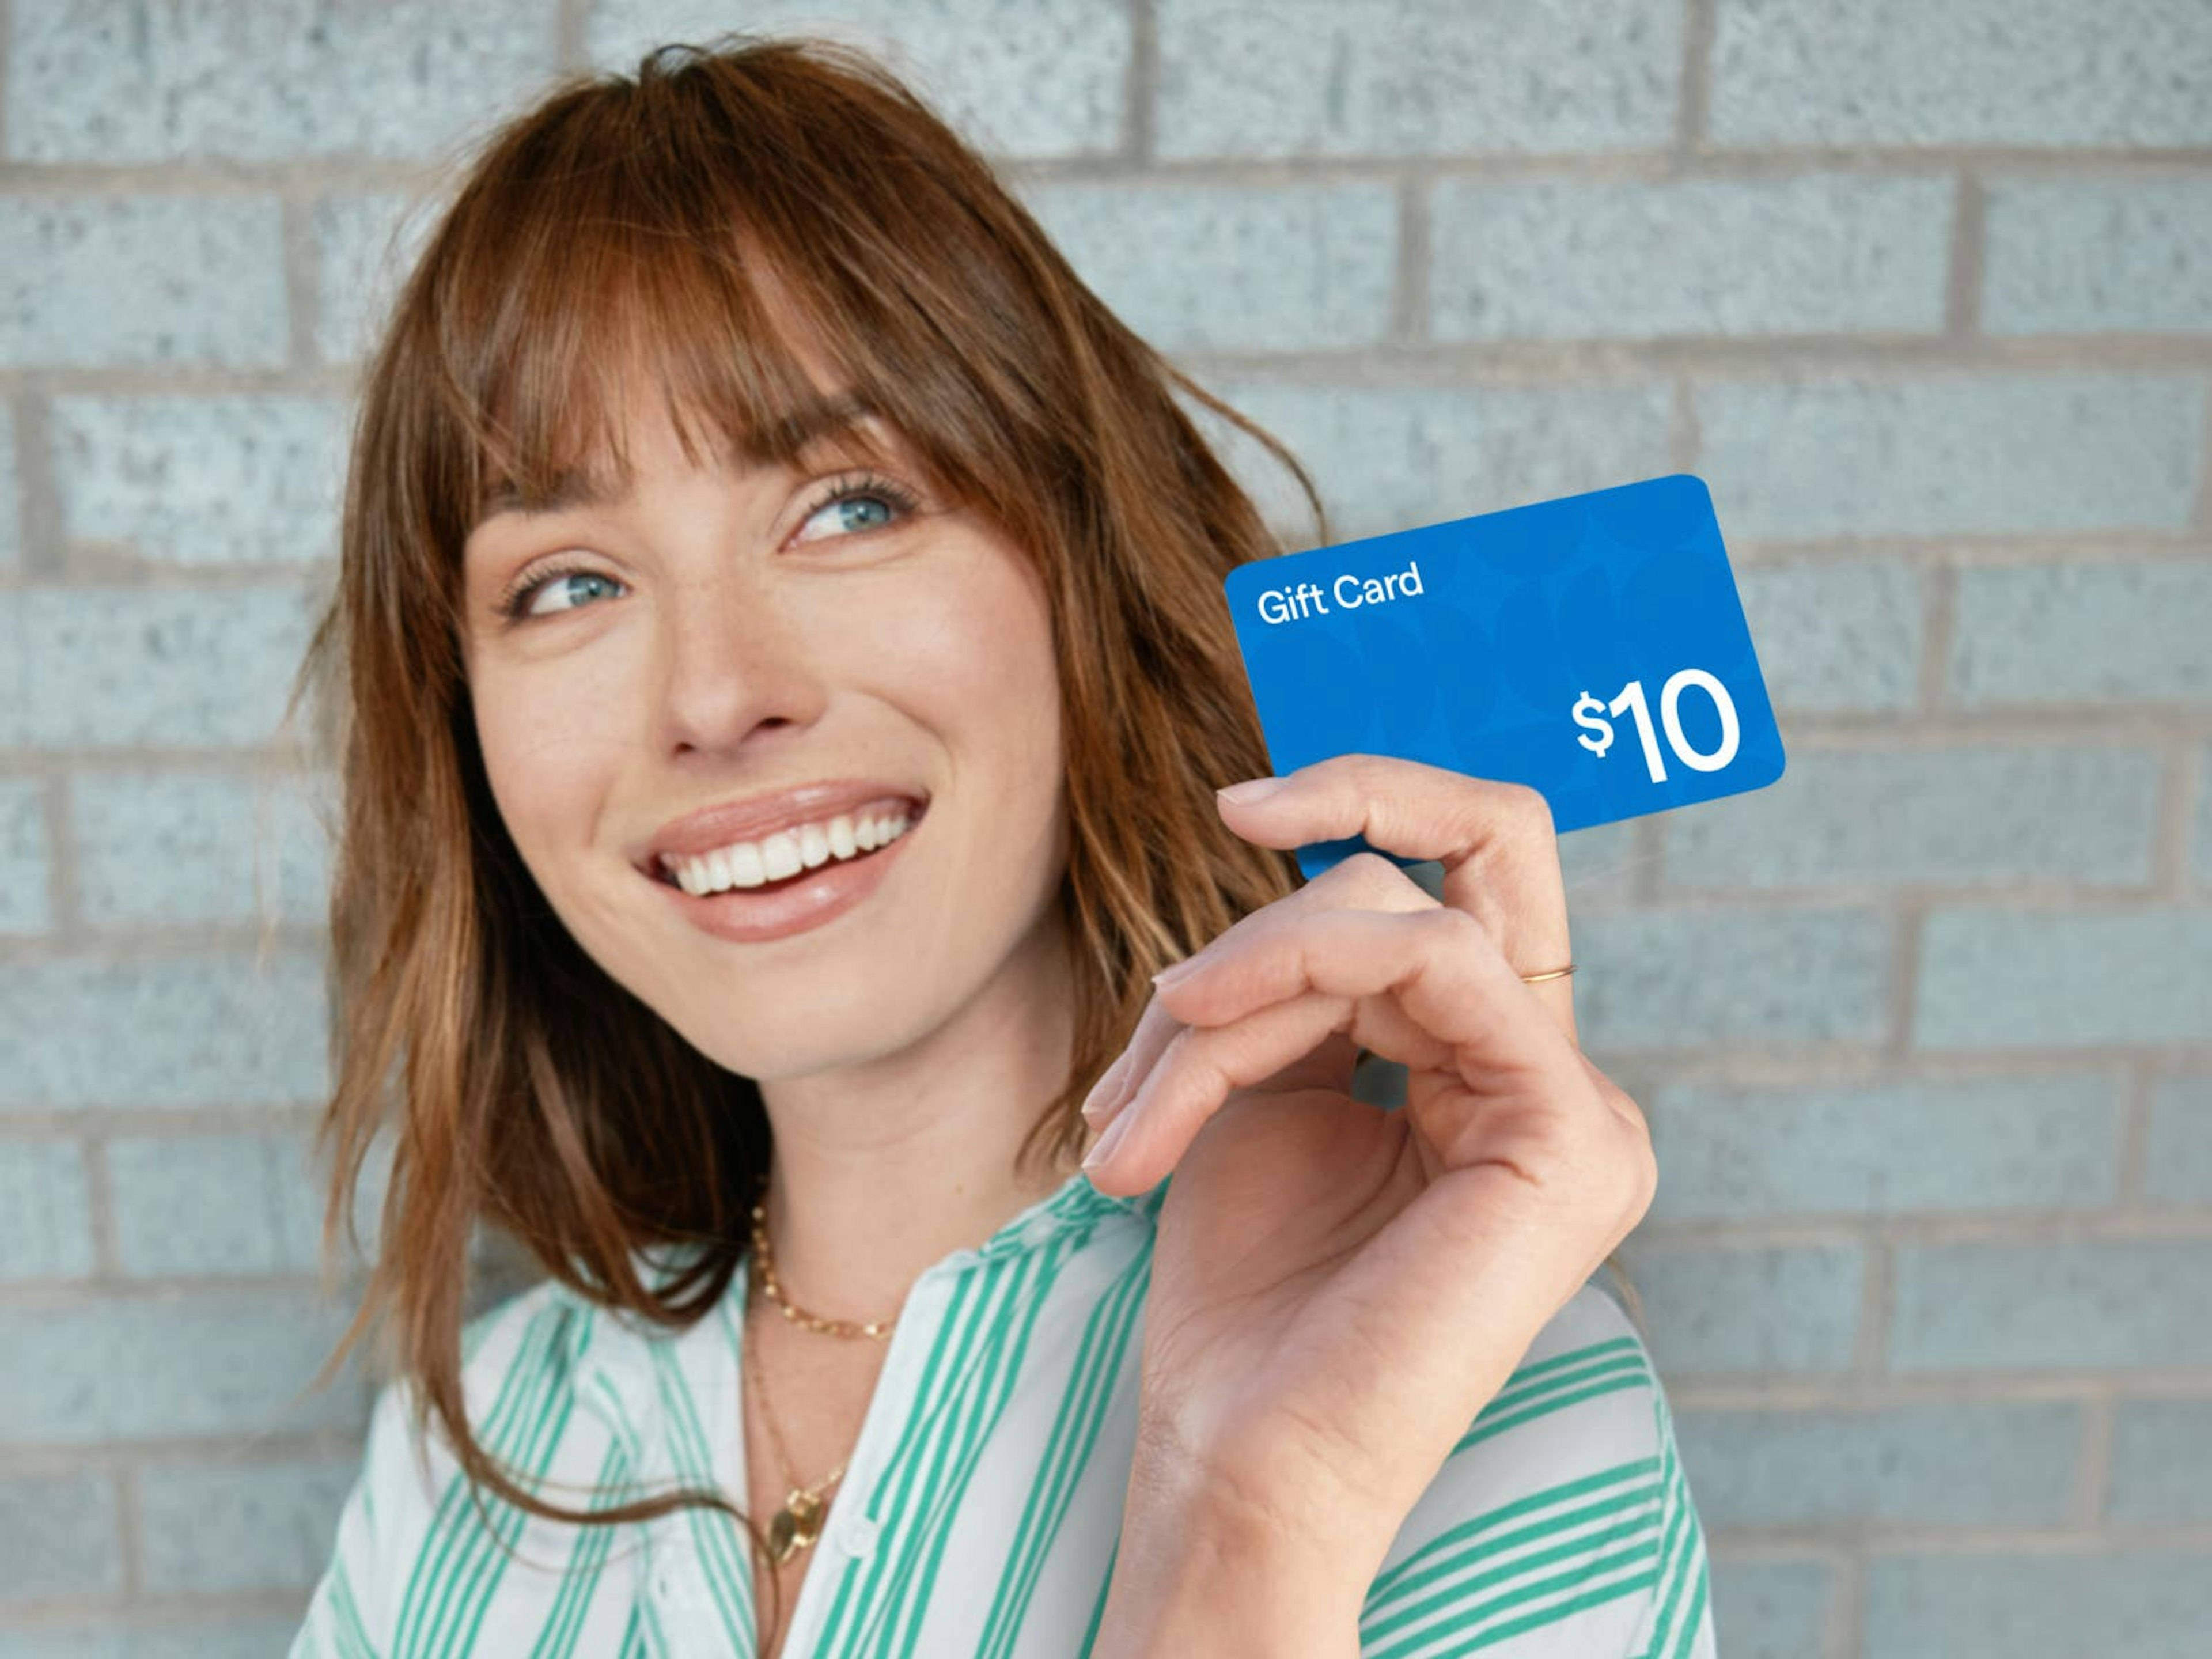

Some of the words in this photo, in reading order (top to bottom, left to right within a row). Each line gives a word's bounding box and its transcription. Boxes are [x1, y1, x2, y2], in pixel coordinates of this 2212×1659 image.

[1258, 583, 1330, 624] Gift
[1333, 561, 1424, 609] Card
[1572, 668, 1740, 783] $10
